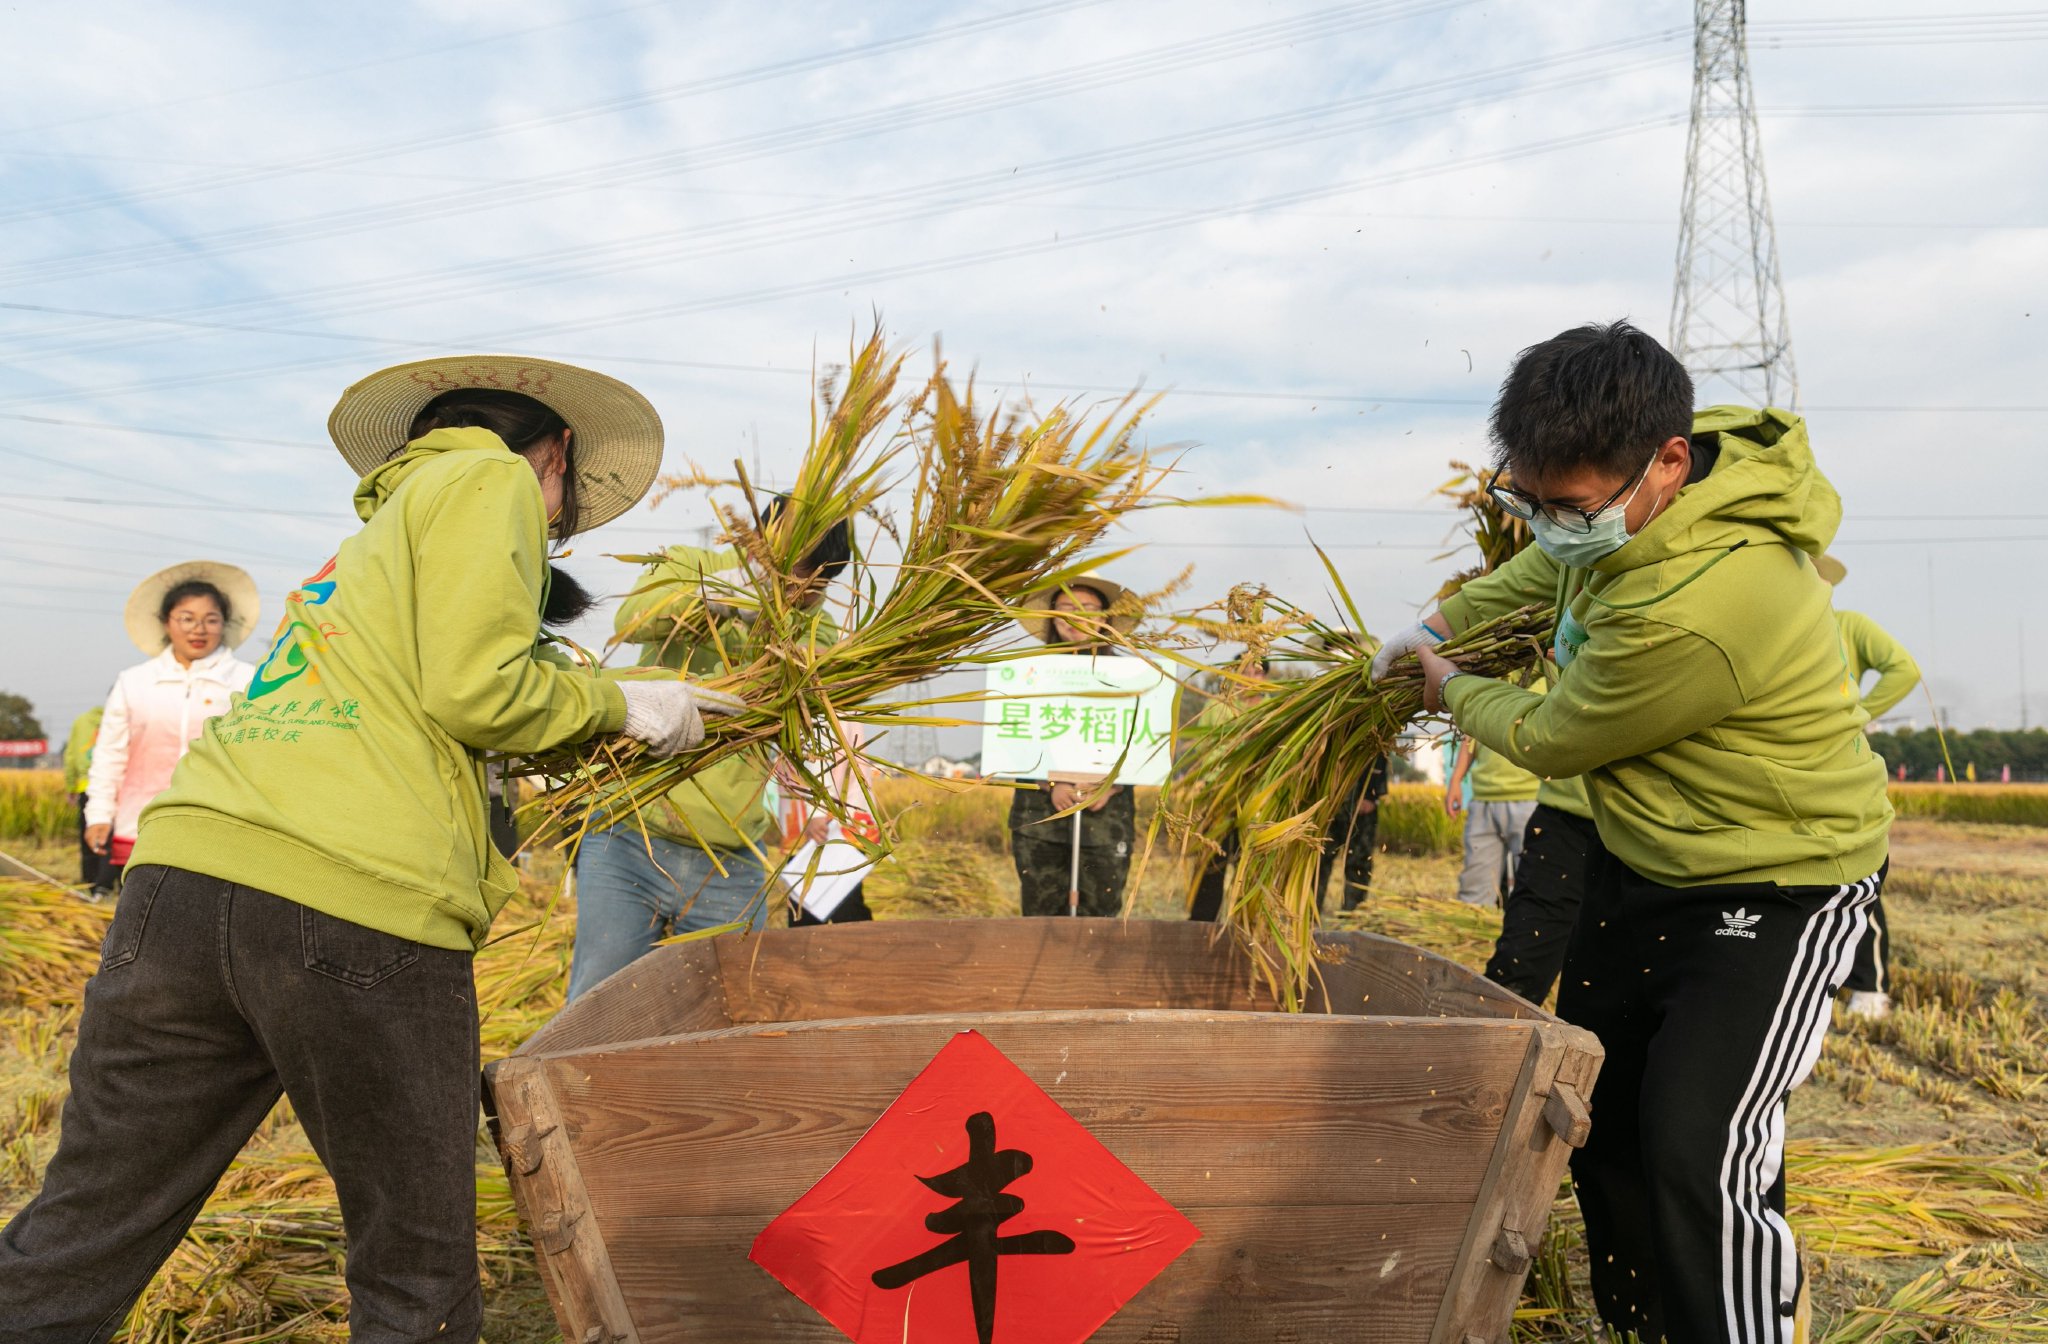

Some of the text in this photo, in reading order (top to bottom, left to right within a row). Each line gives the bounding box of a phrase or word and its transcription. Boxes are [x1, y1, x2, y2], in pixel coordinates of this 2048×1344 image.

[997, 702, 1158, 746] 星梦稻队
[1715, 927, 1757, 939] adidas
[871, 1111, 1076, 1344] 丰
